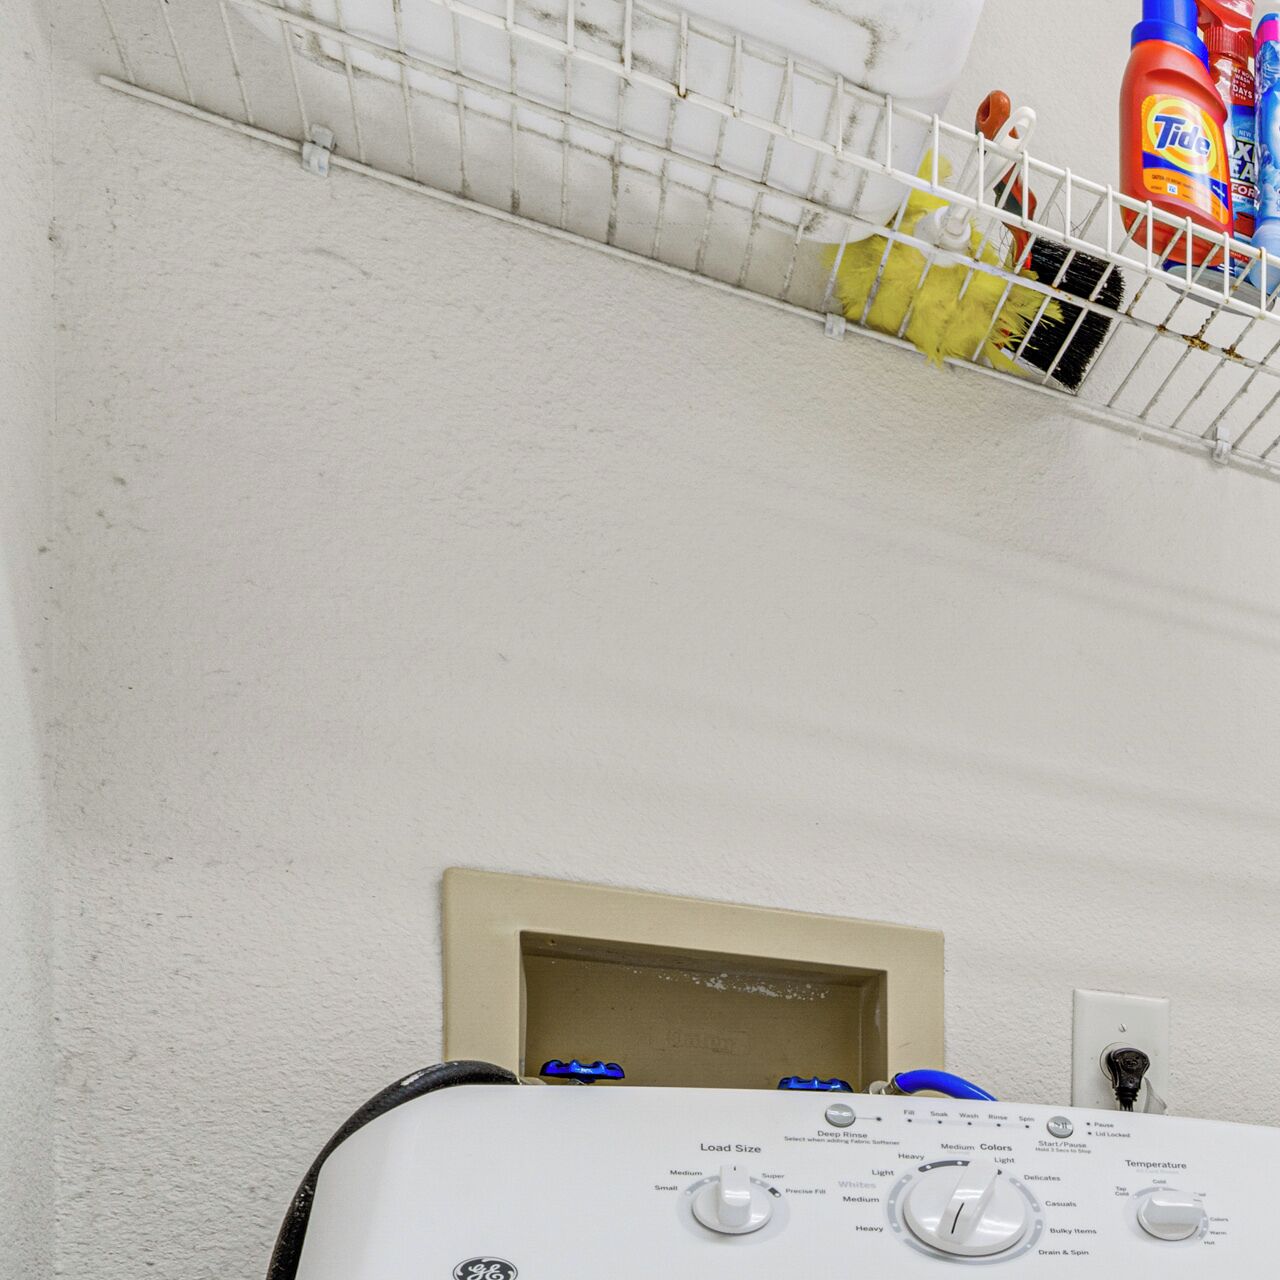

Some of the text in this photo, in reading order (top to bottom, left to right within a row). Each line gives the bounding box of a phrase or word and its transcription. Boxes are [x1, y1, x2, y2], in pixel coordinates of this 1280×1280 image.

[1232, 84, 1253, 98] DAYS
[1154, 114, 1211, 155] Tide
[817, 1130, 841, 1139] Deep
[700, 1143, 762, 1154] Load Size
[980, 1143, 1013, 1152] Colors
[1125, 1159, 1187, 1170] Temperature
[838, 1181, 877, 1189] Whites
